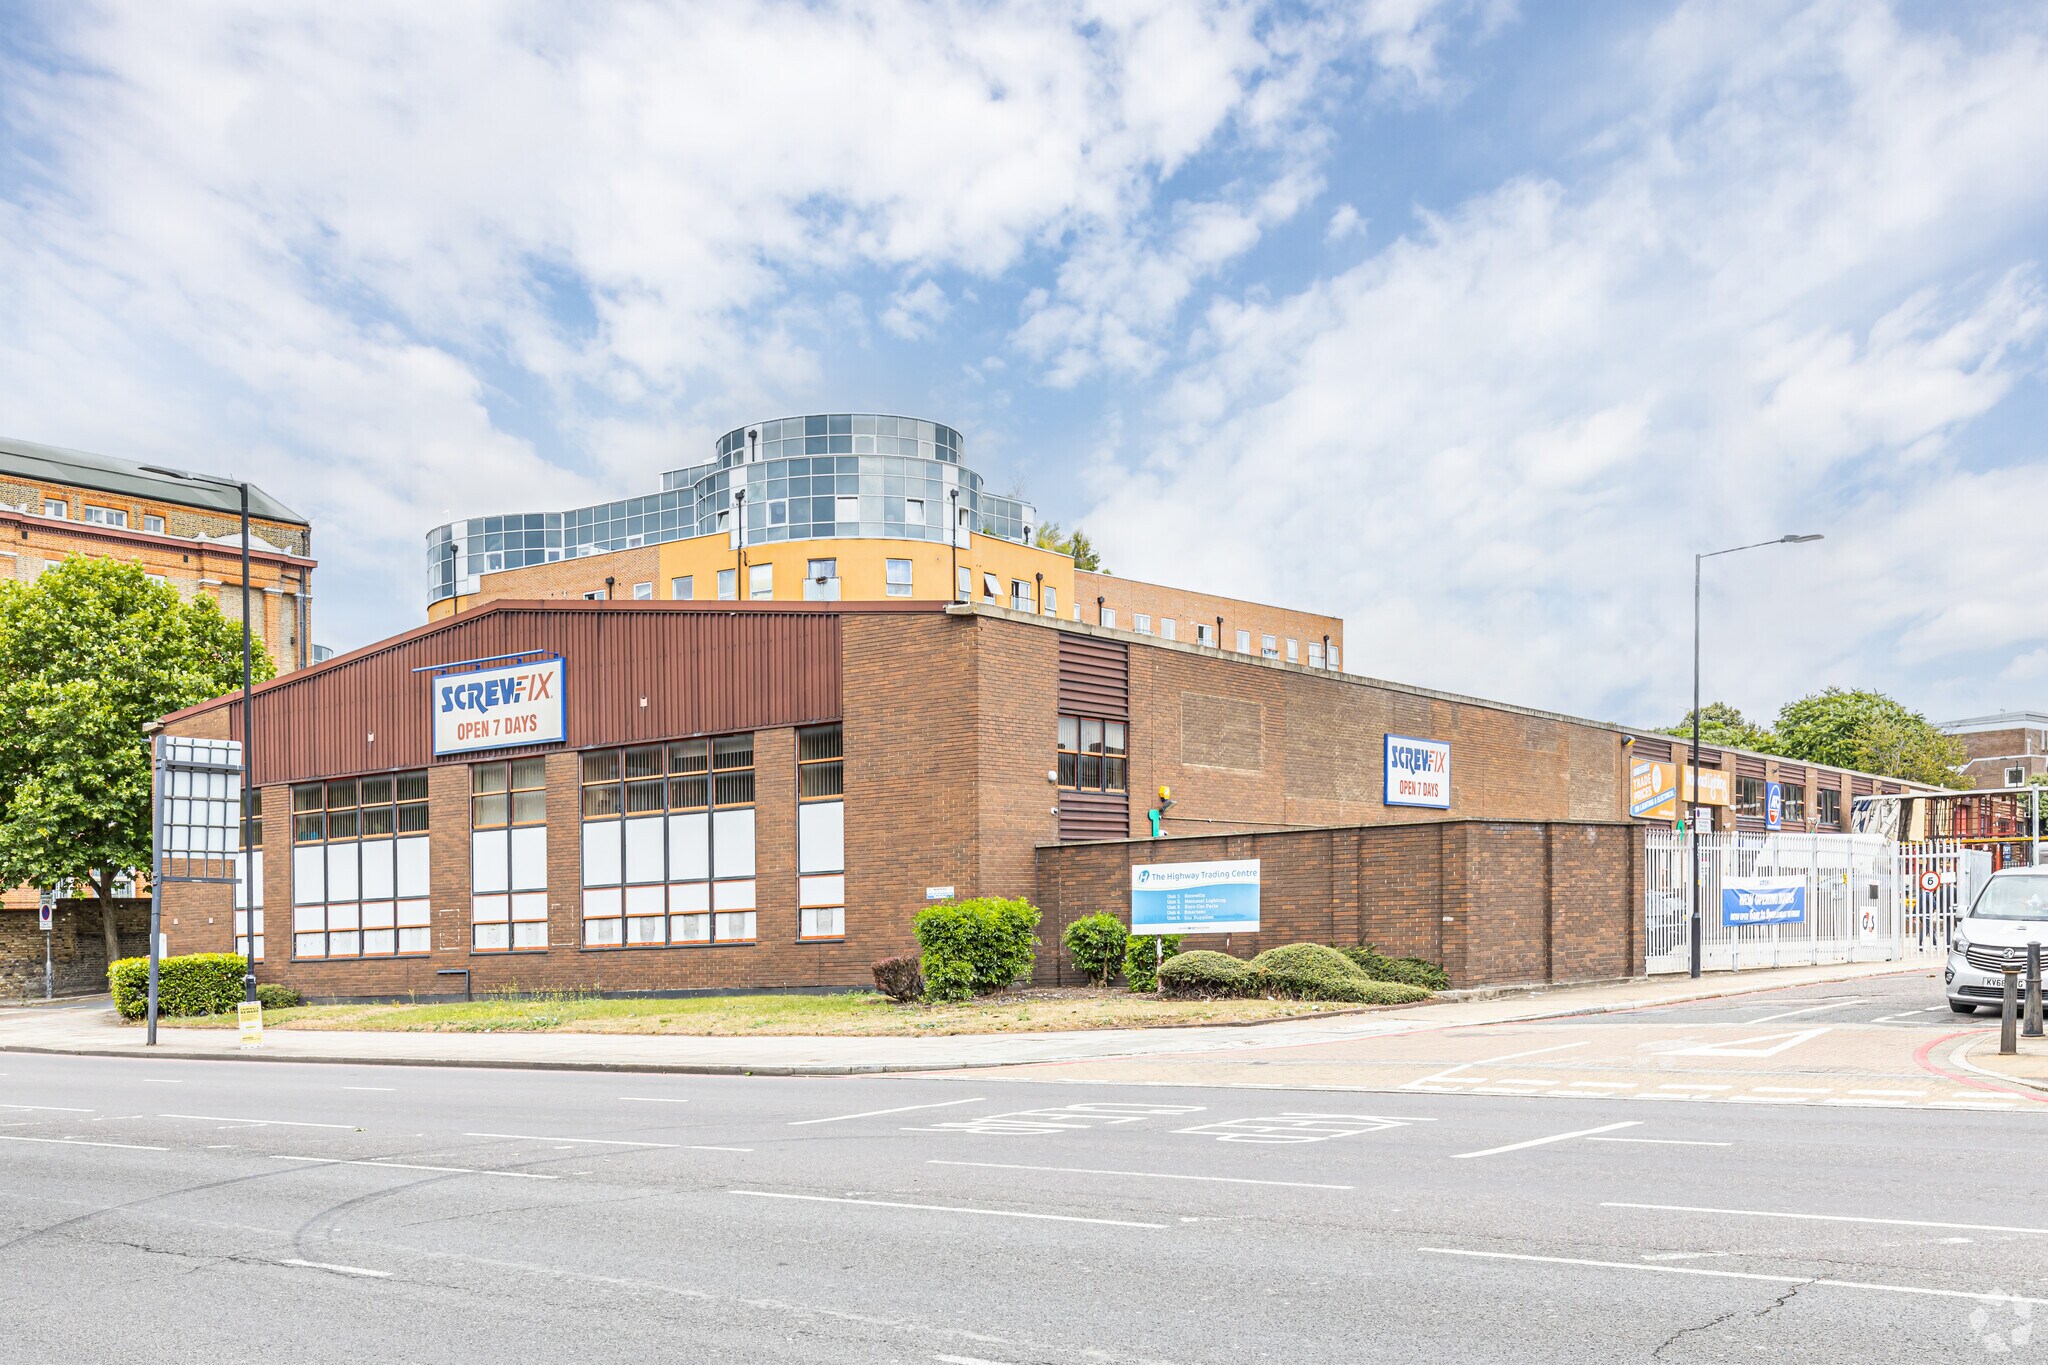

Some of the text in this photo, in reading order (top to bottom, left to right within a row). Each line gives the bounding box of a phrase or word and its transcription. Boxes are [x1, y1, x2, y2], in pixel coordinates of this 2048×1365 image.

[442, 671, 554, 714] SCREWFIX
[457, 714, 537, 740] OPEN 7 DAYS
[1392, 746, 1446, 775] SCREWFIX
[1400, 780, 1438, 797] OPEN 7 DAYS
[1633, 774, 1651, 790] TRADE
[1634, 785, 1652, 802] PRICES
[1167, 872, 1199, 881] Highway
[1201, 870, 1230, 879] Trading
[1232, 869, 1257, 877] Centre
[1928, 876, 1934, 885] 6
[1739, 894, 1754, 905] NEW
[898, 1102, 1207, 1135] CLEAR
[1169, 1112, 1438, 1144] KEEP
